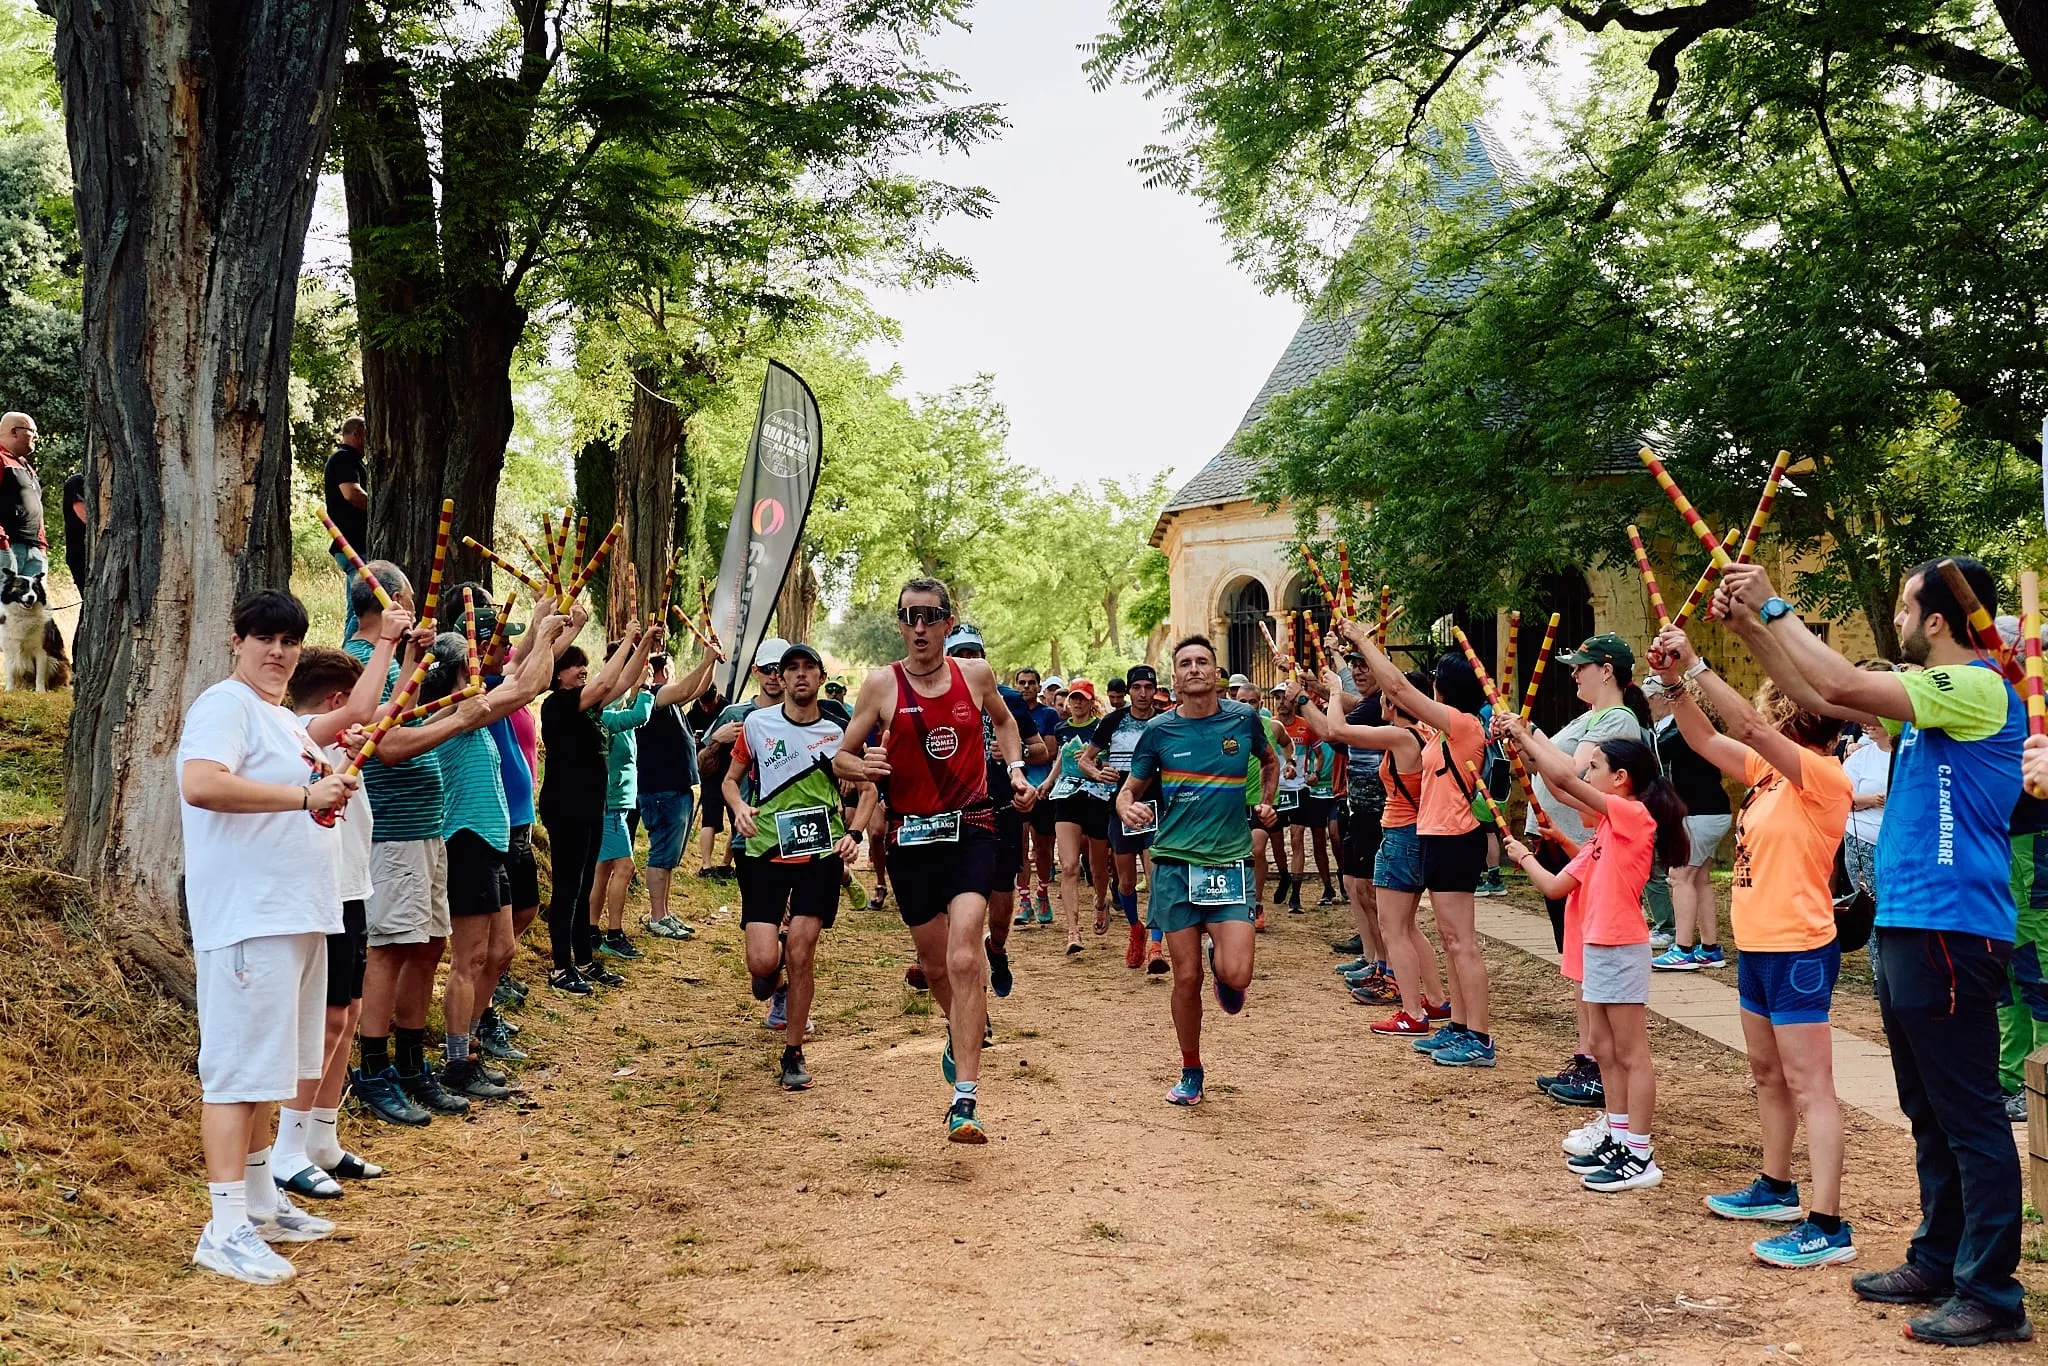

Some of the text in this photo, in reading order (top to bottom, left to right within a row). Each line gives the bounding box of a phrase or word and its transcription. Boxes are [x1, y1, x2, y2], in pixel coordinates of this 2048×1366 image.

[791, 822, 819, 839] 162
[922, 819, 932, 830] EL
[797, 835, 815, 845] DAVID
[1207, 874, 1227, 888] 16
[1797, 1236, 1829, 1253] HOKA
